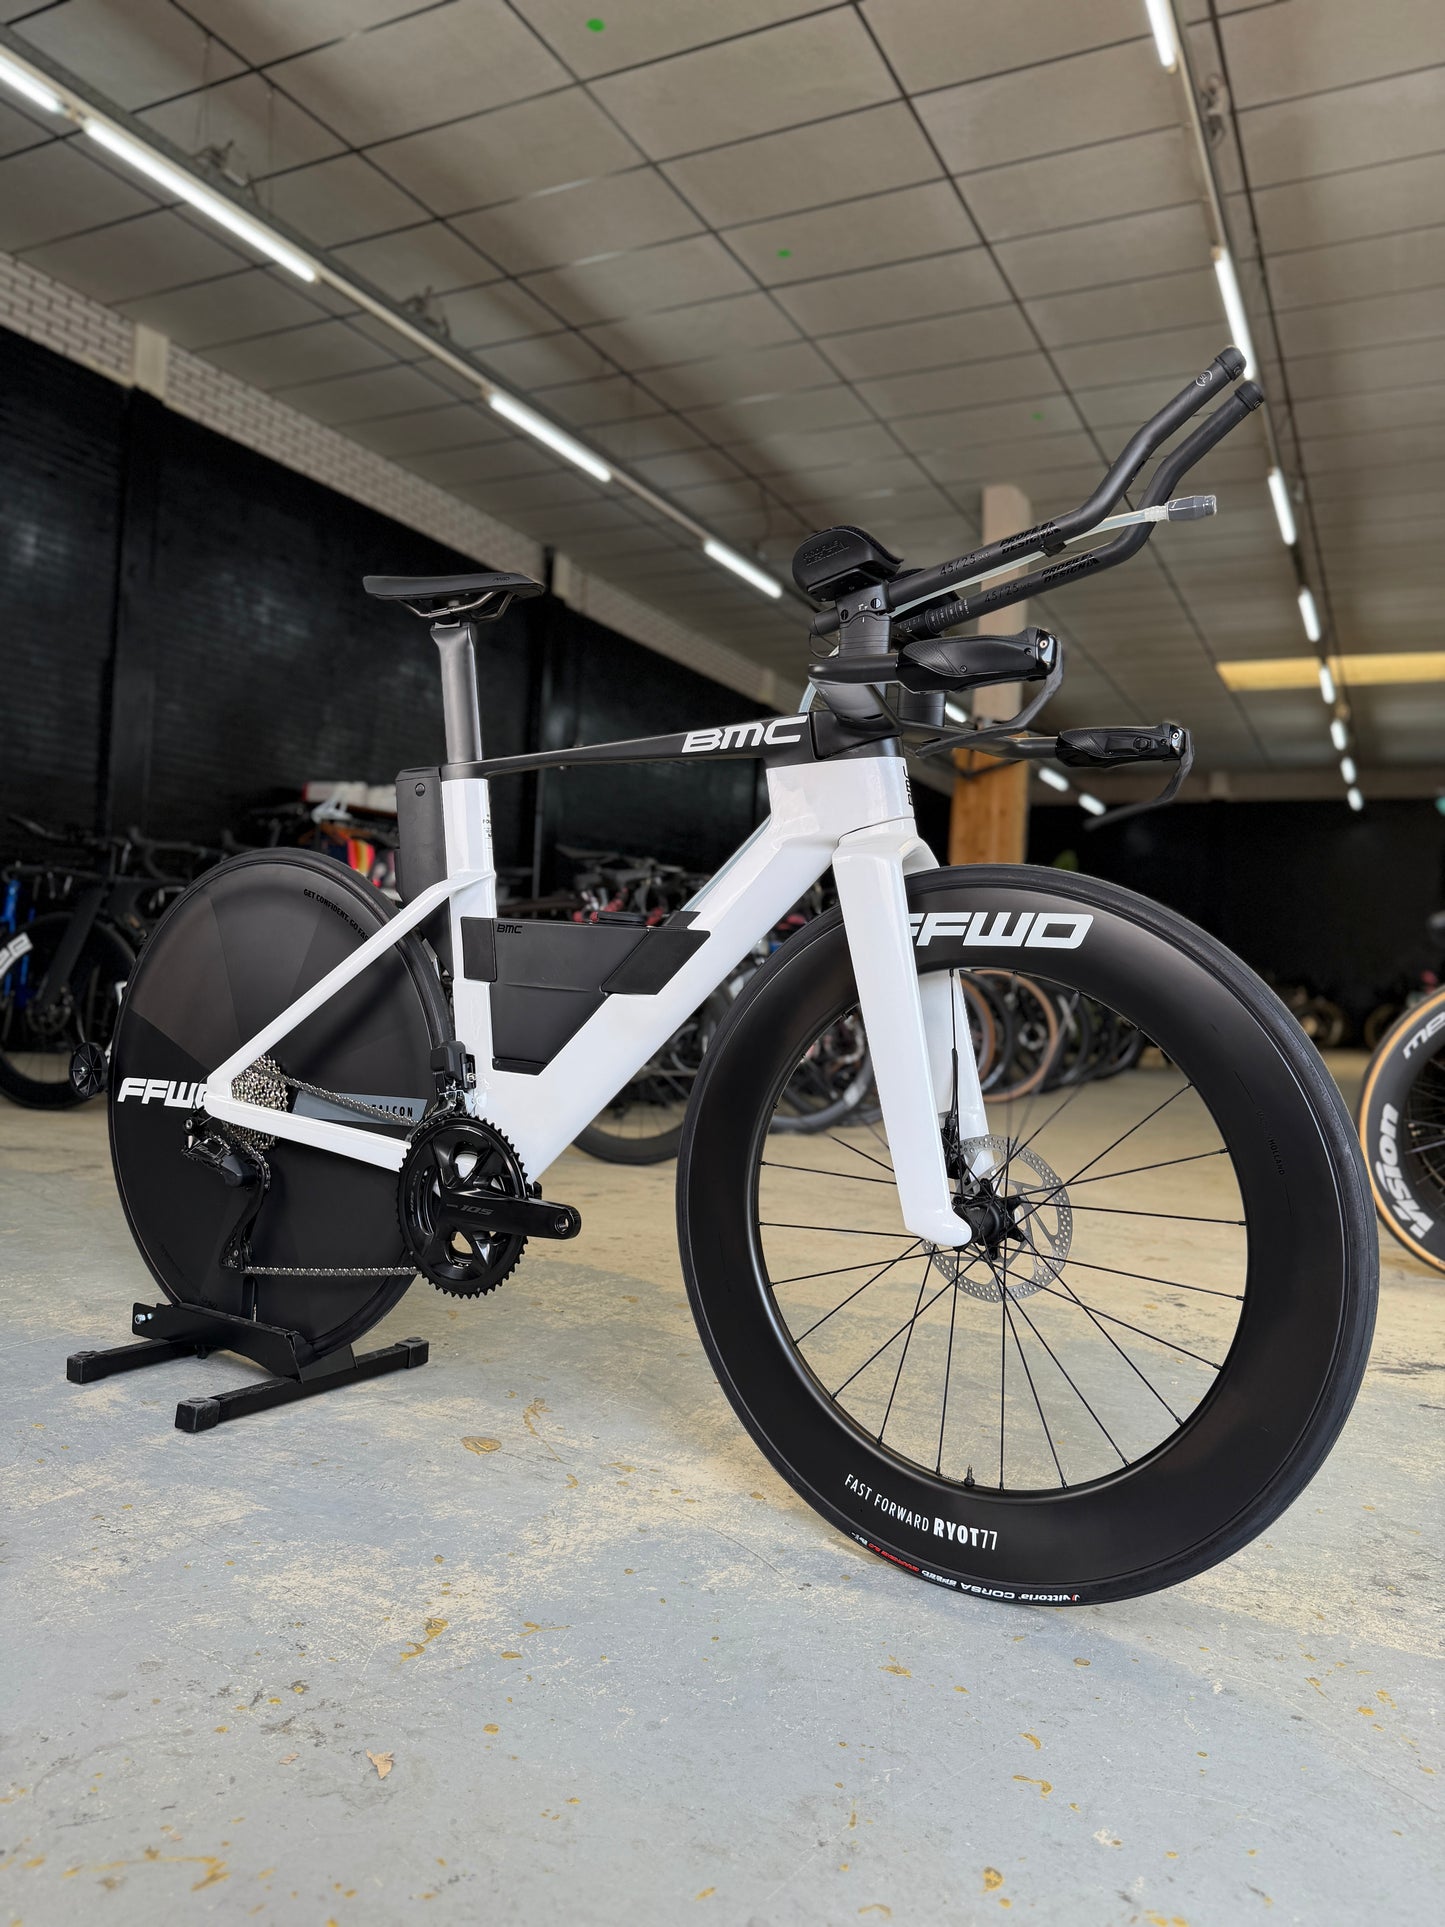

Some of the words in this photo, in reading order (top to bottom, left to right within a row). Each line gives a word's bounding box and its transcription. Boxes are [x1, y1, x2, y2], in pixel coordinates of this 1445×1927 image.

[681, 715, 808, 753] BMC
[303, 888, 316, 899] GET
[350, 919, 359, 930] GO
[496, 923, 523, 935] BMC
[461, 1204, 495, 1216] 105
[844, 1473, 873, 1501] FAST
[873, 1493, 930, 1532] FORWARD
[960, 1582, 1015, 1599] CORSA
